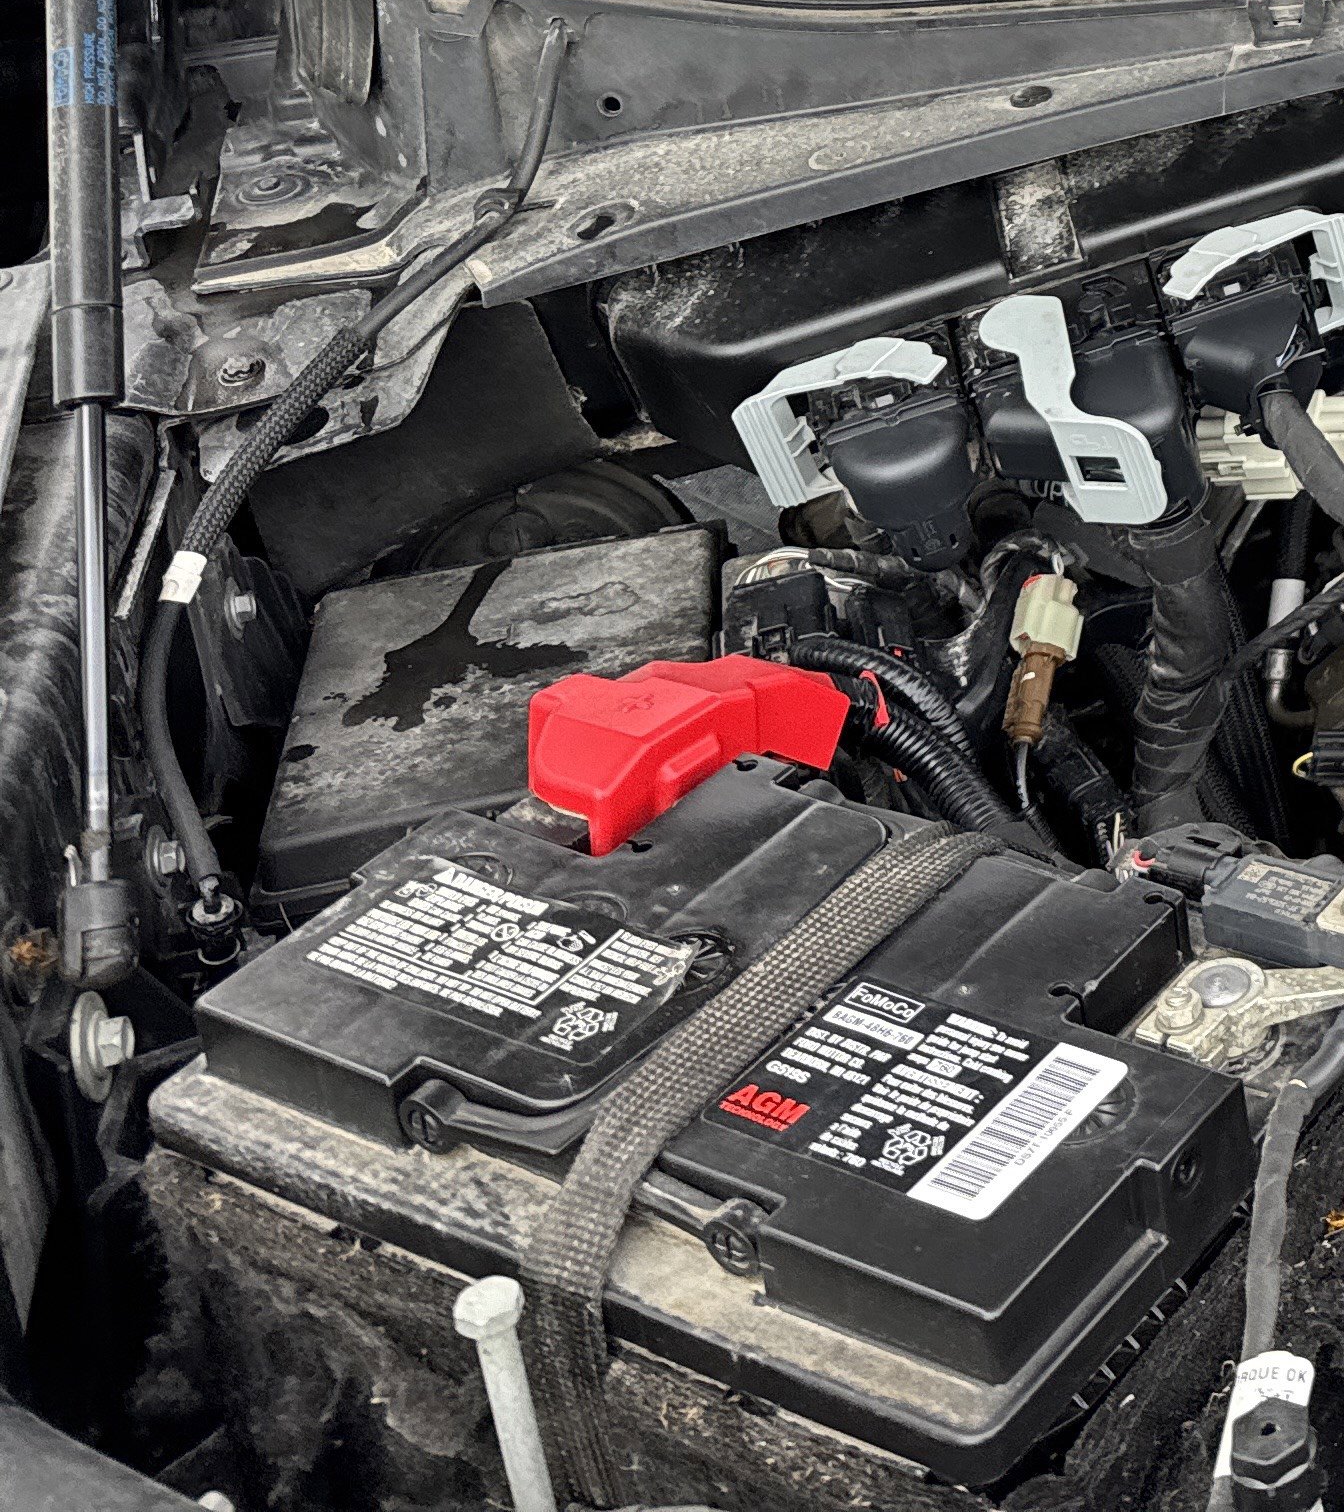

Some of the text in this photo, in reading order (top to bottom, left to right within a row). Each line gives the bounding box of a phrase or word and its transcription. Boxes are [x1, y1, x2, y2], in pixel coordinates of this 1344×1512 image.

[83, 32, 95, 78] PRESSURE
[850, 986, 915, 1019] FoMoCo
[726, 1083, 811, 1126] AGM
[1238, 1367, 1308, 1384] RQUE OK
